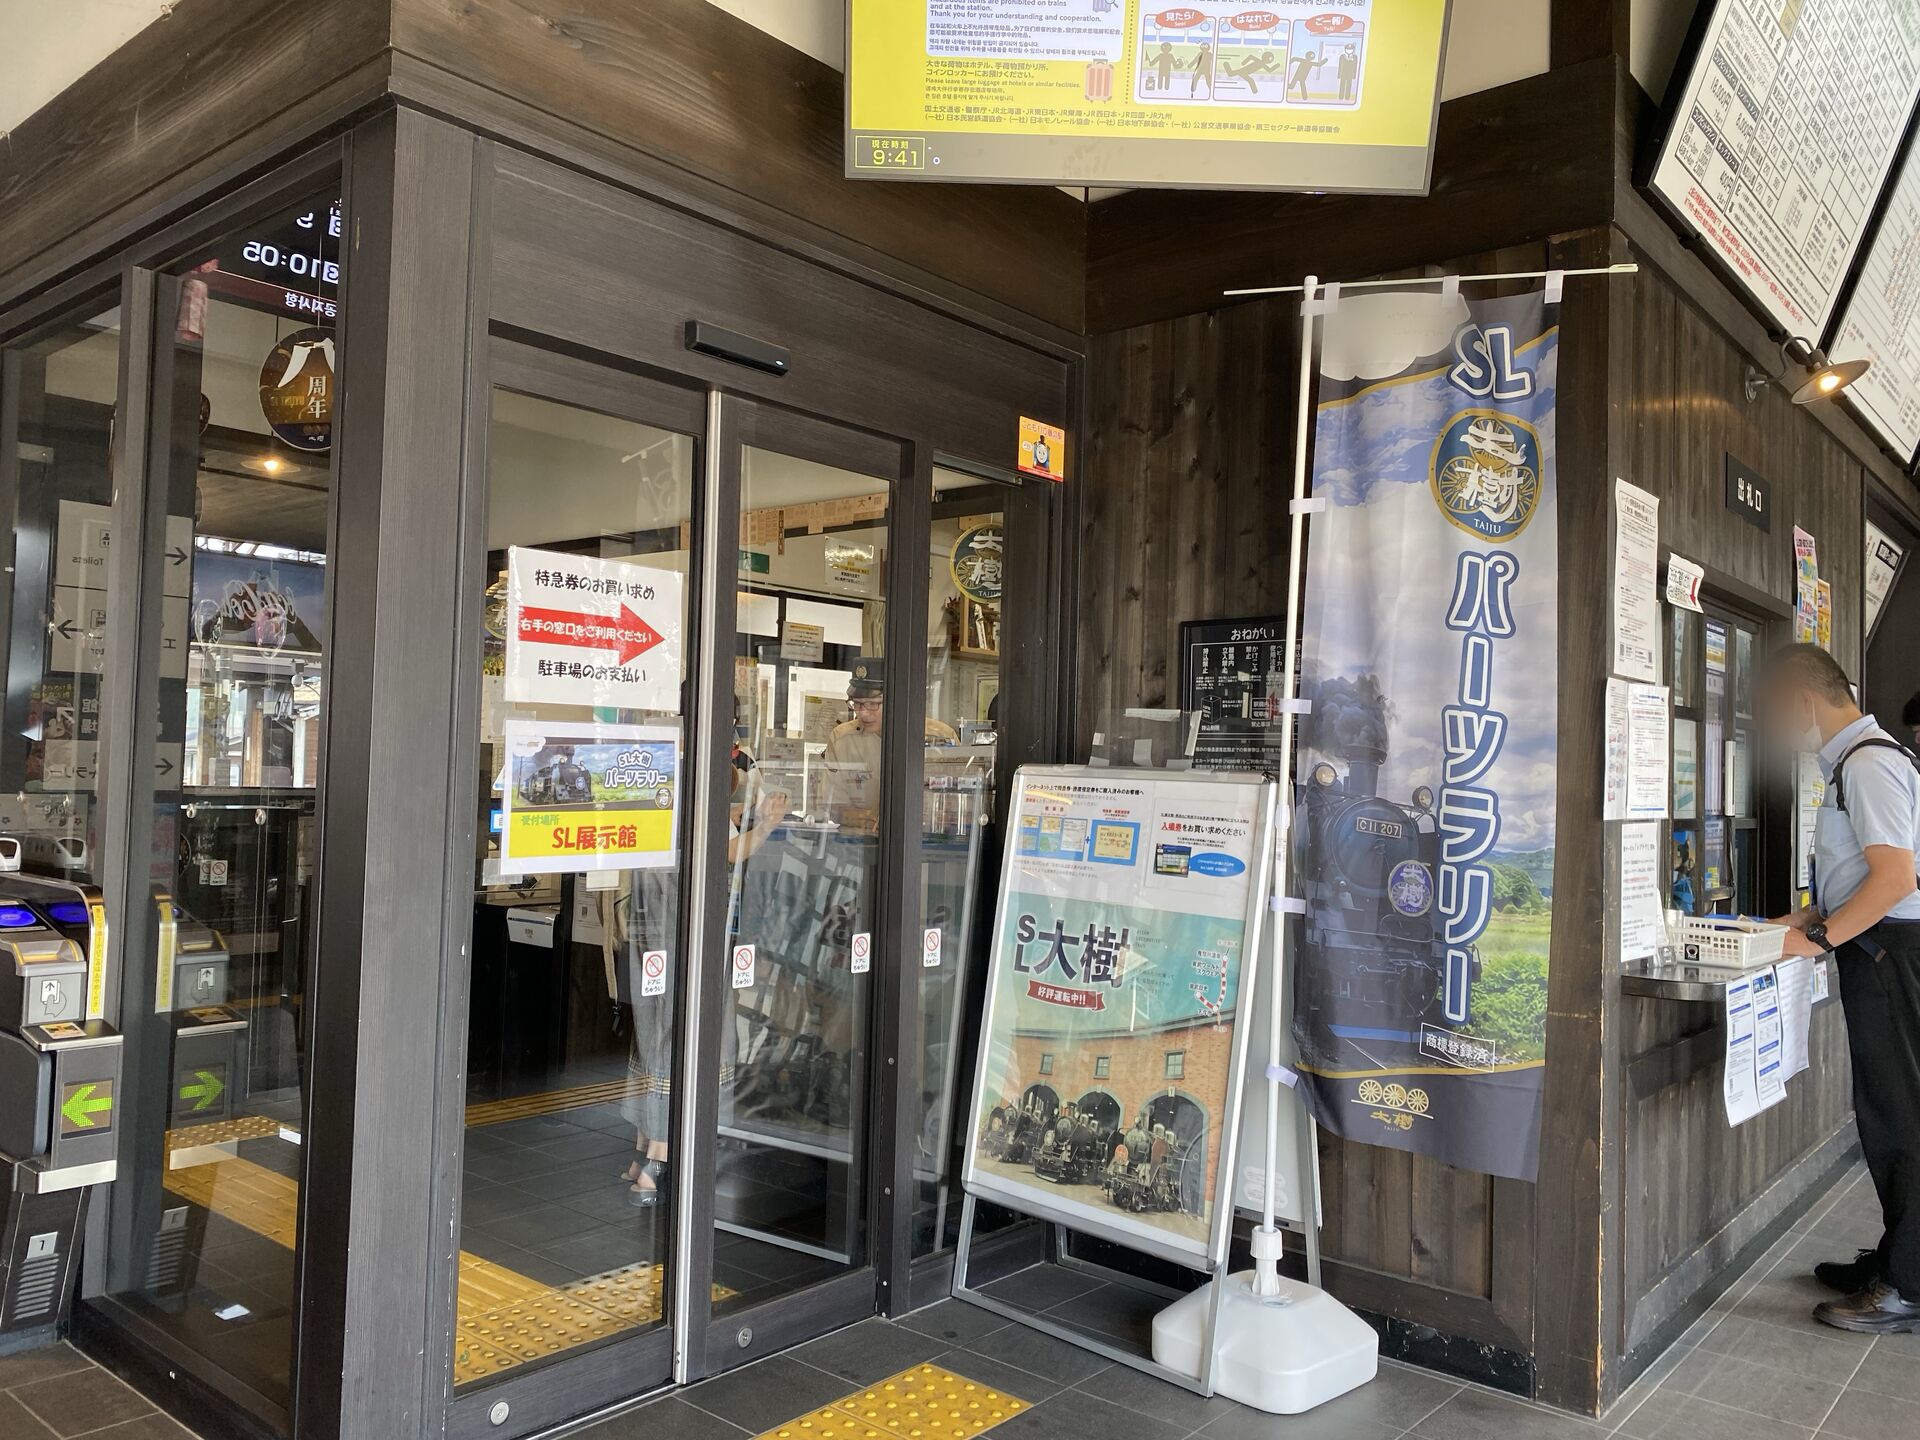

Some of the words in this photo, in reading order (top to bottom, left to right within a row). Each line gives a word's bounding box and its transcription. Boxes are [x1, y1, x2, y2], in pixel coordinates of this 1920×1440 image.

[953, 11, 966, 19] you
[978, 12, 994, 20] your
[995, 12, 1043, 21] understanding
[1059, 14, 1102, 23] cooperation.
[871, 139, 909, 149] 現在時刻
[873, 149, 918, 167] 9:41
[1447, 323, 1536, 403] SL
[307, 376, 328, 419] 周年
[1737, 477, 1762, 513] 出札口
[1473, 517, 1502, 535] TAIJU
[535, 569, 655, 601] 特急券のお買い求め
[521, 618, 653, 644] 右手の窓口をご利用ください
[1230, 627, 1275, 641] おねがい
[538, 659, 647, 683] 駐車場のお支払い
[617, 750, 653, 768] SL大樹
[604, 766, 669, 788] パーツラリー
[1438, 550, 1521, 1025] パーツラリー
[521, 814, 561, 827] 受付場所
[1161, 822, 1246, 837] 入場券をお買い求めください
[1381, 823, 1400, 836] 207
[552, 825, 638, 851] SL展示館
[1037, 985, 1087, 1006] 好評運転中!!
[1426, 1031, 1489, 1063] 商標登録済
[39, 1239, 46, 1251] 1
